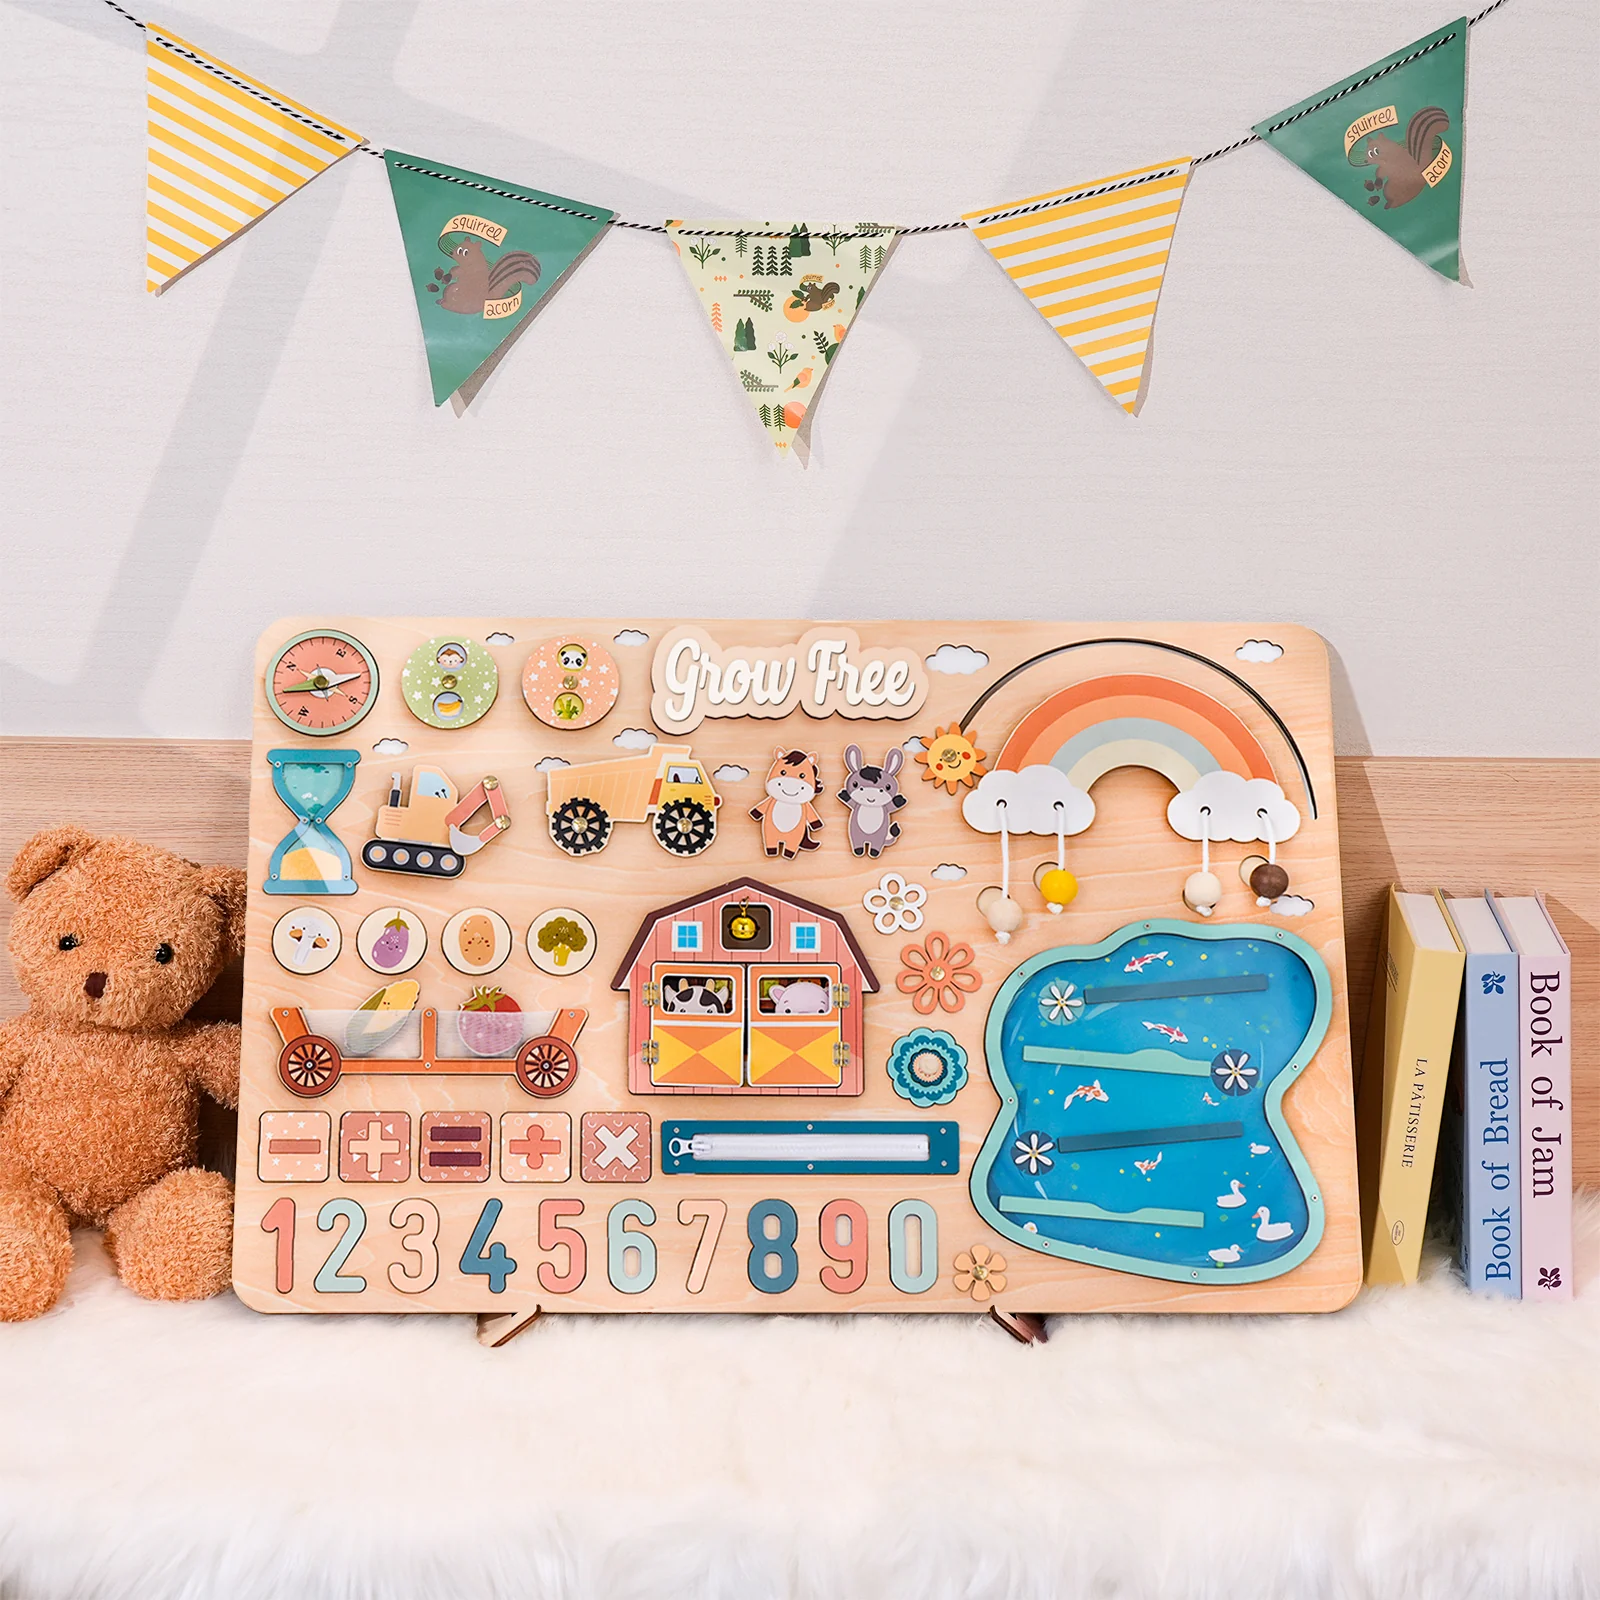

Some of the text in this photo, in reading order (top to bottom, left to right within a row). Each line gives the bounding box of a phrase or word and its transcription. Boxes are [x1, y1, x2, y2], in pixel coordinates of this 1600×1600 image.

[1346, 108, 1395, 143] squirrel
[1425, 148, 1451, 183] acorn
[451, 216, 503, 242] squirrel
[486, 297, 520, 317] acorn
[286, 661, 297, 672] N
[336, 648, 347, 659] E
[664, 637, 916, 722] Grow Free
[298, 705, 310, 718] W
[348, 695, 359, 705] S
[1530, 970, 1564, 1199] Book of Jam
[1401, 1058, 1428, 1168] LA PÂTISSERIE
[1480, 1058, 1511, 1281] Book of Bread
[261, 1197, 939, 1295] 1 2 3 4 5 6 7 8 9 0
